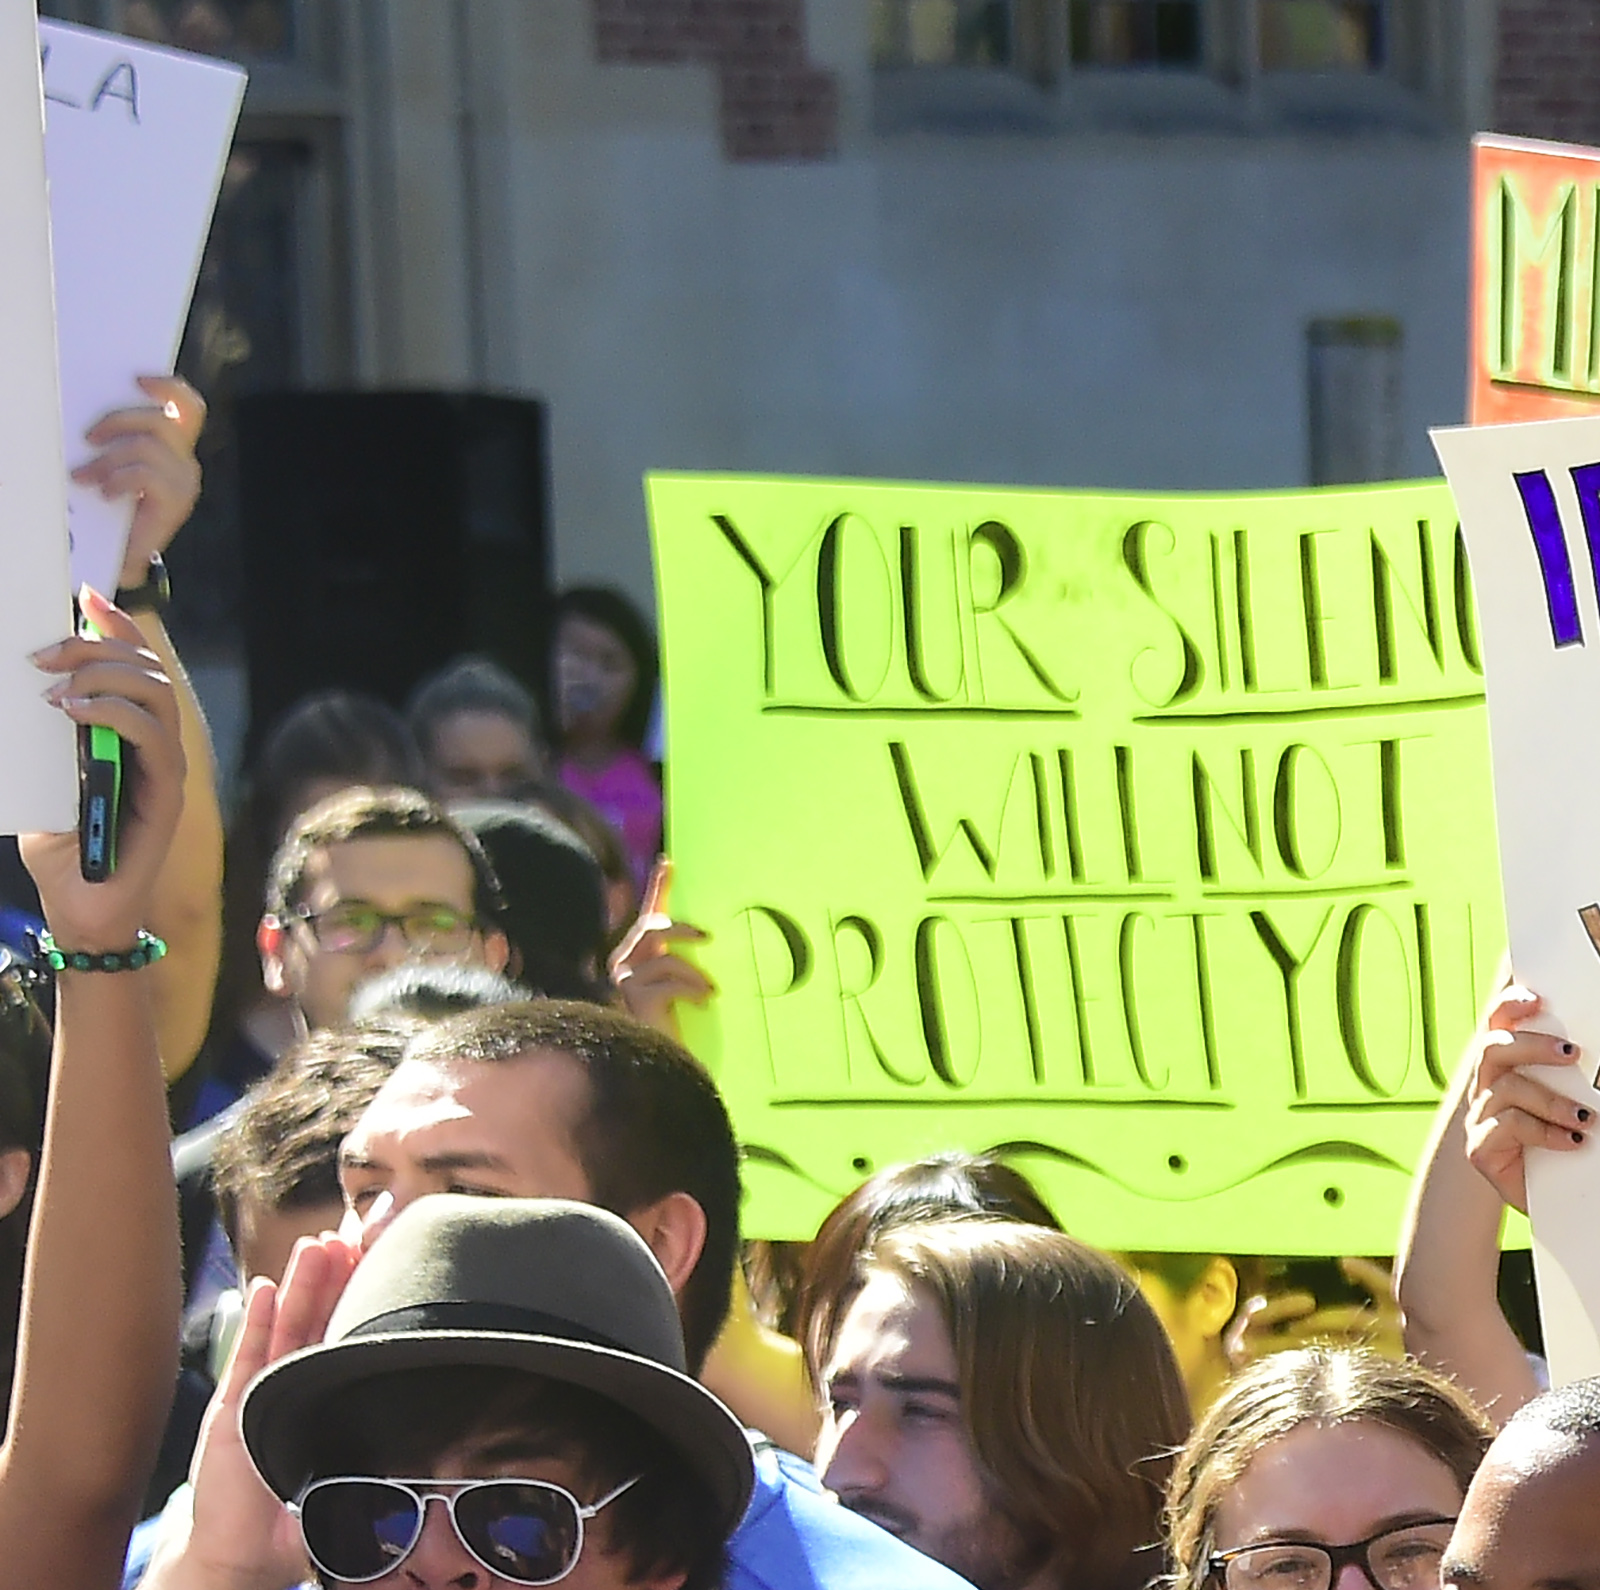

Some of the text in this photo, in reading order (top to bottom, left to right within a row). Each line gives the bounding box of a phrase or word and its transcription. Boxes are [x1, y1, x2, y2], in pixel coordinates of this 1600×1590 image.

[709, 510, 1081, 704] YOUR
[888, 733, 1434, 887] WILL NOT
[732, 902, 1227, 1092] PROTECT
